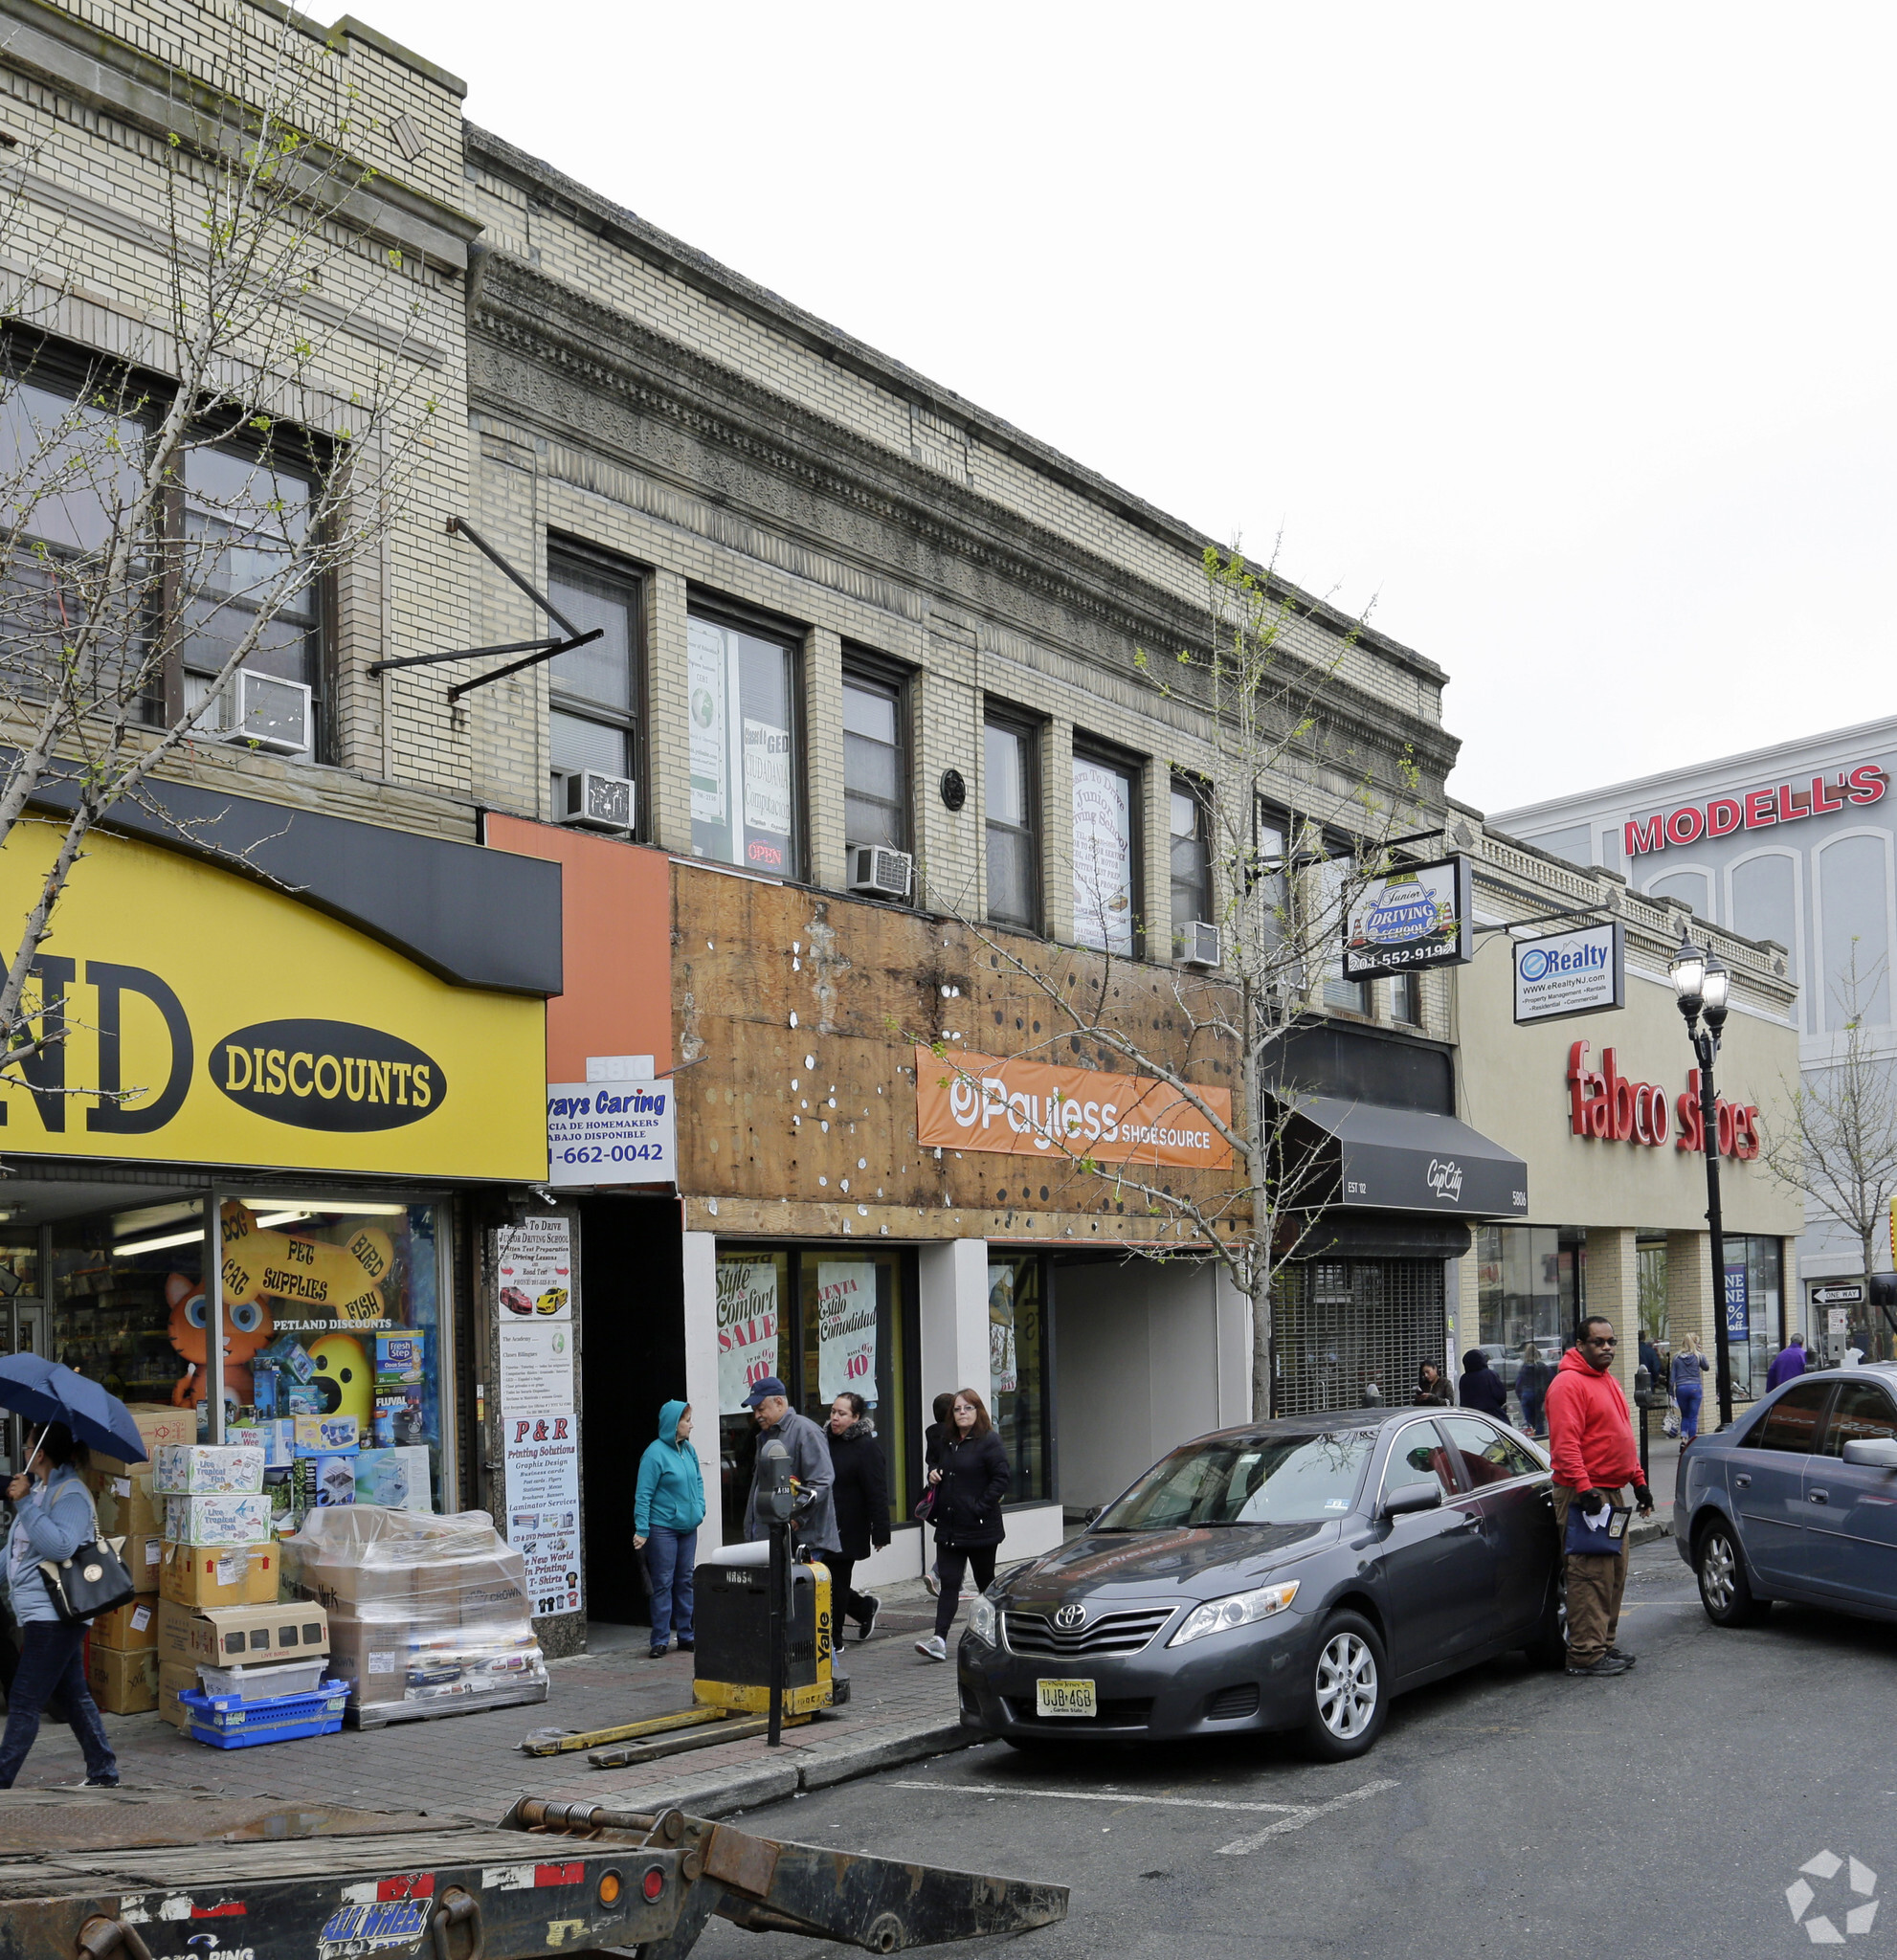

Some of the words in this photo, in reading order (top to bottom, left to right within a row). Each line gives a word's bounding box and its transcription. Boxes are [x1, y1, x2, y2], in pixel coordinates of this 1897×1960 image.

[767, 734, 789, 754] GED
[1076, 789, 1113, 817] Junior
[1104, 775, 1125, 812] Drive
[1623, 764, 1886, 858] MODELL'S
[1099, 811, 1128, 854] School
[748, 842, 782, 865] OPEN
[1382, 889, 1421, 906] Junior
[1369, 904, 1434, 927] DRIVING
[1379, 923, 1427, 940] SCHOOL
[1350, 942, 1454, 971] 201-552-9192
[1531, 1001, 1561, 1012] Residential
[1566, 994, 1598, 1005] Commercial
[1548, 989, 1581, 1000] Management
[226, 1044, 433, 1108] DISCOUNTS
[595, 1089, 666, 1116] Caring
[1567, 1039, 1669, 1147] fabco
[569, 1122, 584, 1130] DE
[586, 1119, 659, 1129] HOMEMAKERS
[981, 1077, 1119, 1150] Payless
[585, 1130, 647, 1140] DISPONIBLE
[1348, 1181, 1358, 1193] EST
[1512, 1191, 1527, 1207] 5806
[221, 1211, 248, 1242] DOG
[522, 1233, 547, 1244] DRIVING
[547, 1233, 569, 1244] SCHOOL
[536, 1245, 569, 1254] Preparation
[287, 1239, 314, 1265] PET
[350, 1234, 384, 1278] BIRD
[512, 1254, 534, 1262] Driving
[221, 1258, 251, 1296] CAT
[262, 1266, 328, 1302] SUPPLIES
[716, 1263, 750, 1303] Style
[737, 1290, 746, 1300] &
[818, 1279, 859, 1301] VENTA
[1841, 1290, 1857, 1299] WAY
[345, 1291, 381, 1321] FISH
[717, 1284, 774, 1328] Comfort
[818, 1295, 847, 1321] Estilo
[273, 1319, 327, 1331] PETLAND
[329, 1318, 392, 1329] DISCOUNTS
[718, 1313, 778, 1355] SALE
[820, 1306, 878, 1343] Comodidad
[390, 1341, 411, 1350] Fresh
[391, 1349, 410, 1358] Step
[743, 1360, 770, 1388] 40
[843, 1354, 869, 1381] 40
[375, 1395, 408, 1407] FLUVAL
[514, 1420, 529, 1443] P
[533, 1419, 549, 1442] &
[552, 1417, 569, 1440] R
[507, 1447, 539, 1459] Printing
[539, 1444, 575, 1457] Solutions
[196, 1467, 226, 1476] Tropical
[515, 1460, 544, 1470] Graphix
[545, 1458, 569, 1467] Design
[508, 1501, 547, 1512] Laminator
[547, 1498, 577, 1507] Services
[204, 1516, 236, 1525] Tropical
[531, 1554, 548, 1565] New
[549, 1550, 574, 1562] World
[536, 1563, 568, 1575] Printing
[539, 1574, 563, 1586] Shirts
[318, 1584, 339, 1615] York
[490, 1589, 522, 1602] CROWN
[817, 1612, 830, 1664] Yale
[322, 1905, 365, 1942] ALL
[359, 1899, 430, 1938] WHEEL
